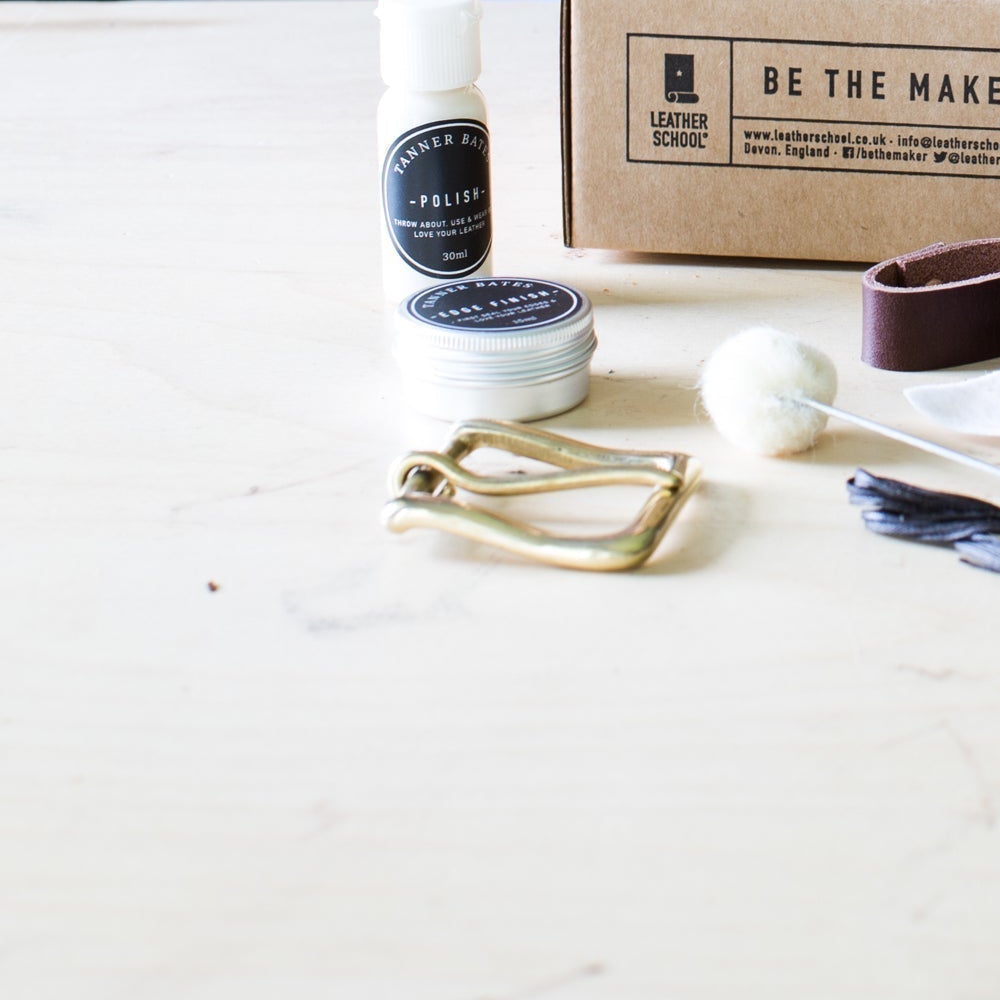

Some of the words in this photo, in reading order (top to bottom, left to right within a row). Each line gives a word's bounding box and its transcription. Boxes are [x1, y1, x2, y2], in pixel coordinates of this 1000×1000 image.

[763, 65, 803, 96] BE
[824, 68, 886, 100] THE
[650, 110, 708, 130] LEATHER
[393, 133, 454, 176] TANNER
[461, 133, 490, 163] BATE
[785, 143, 830, 160] England
[394, 218, 418, 228] THROW
[450, 217, 466, 227] USE
[413, 229, 434, 239] LOVE
[436, 227, 457, 238] YOUR
[459, 221, 486, 236] LEATHER
[442, 248, 469, 262] 30ml
[476, 280, 534, 289] BATES
